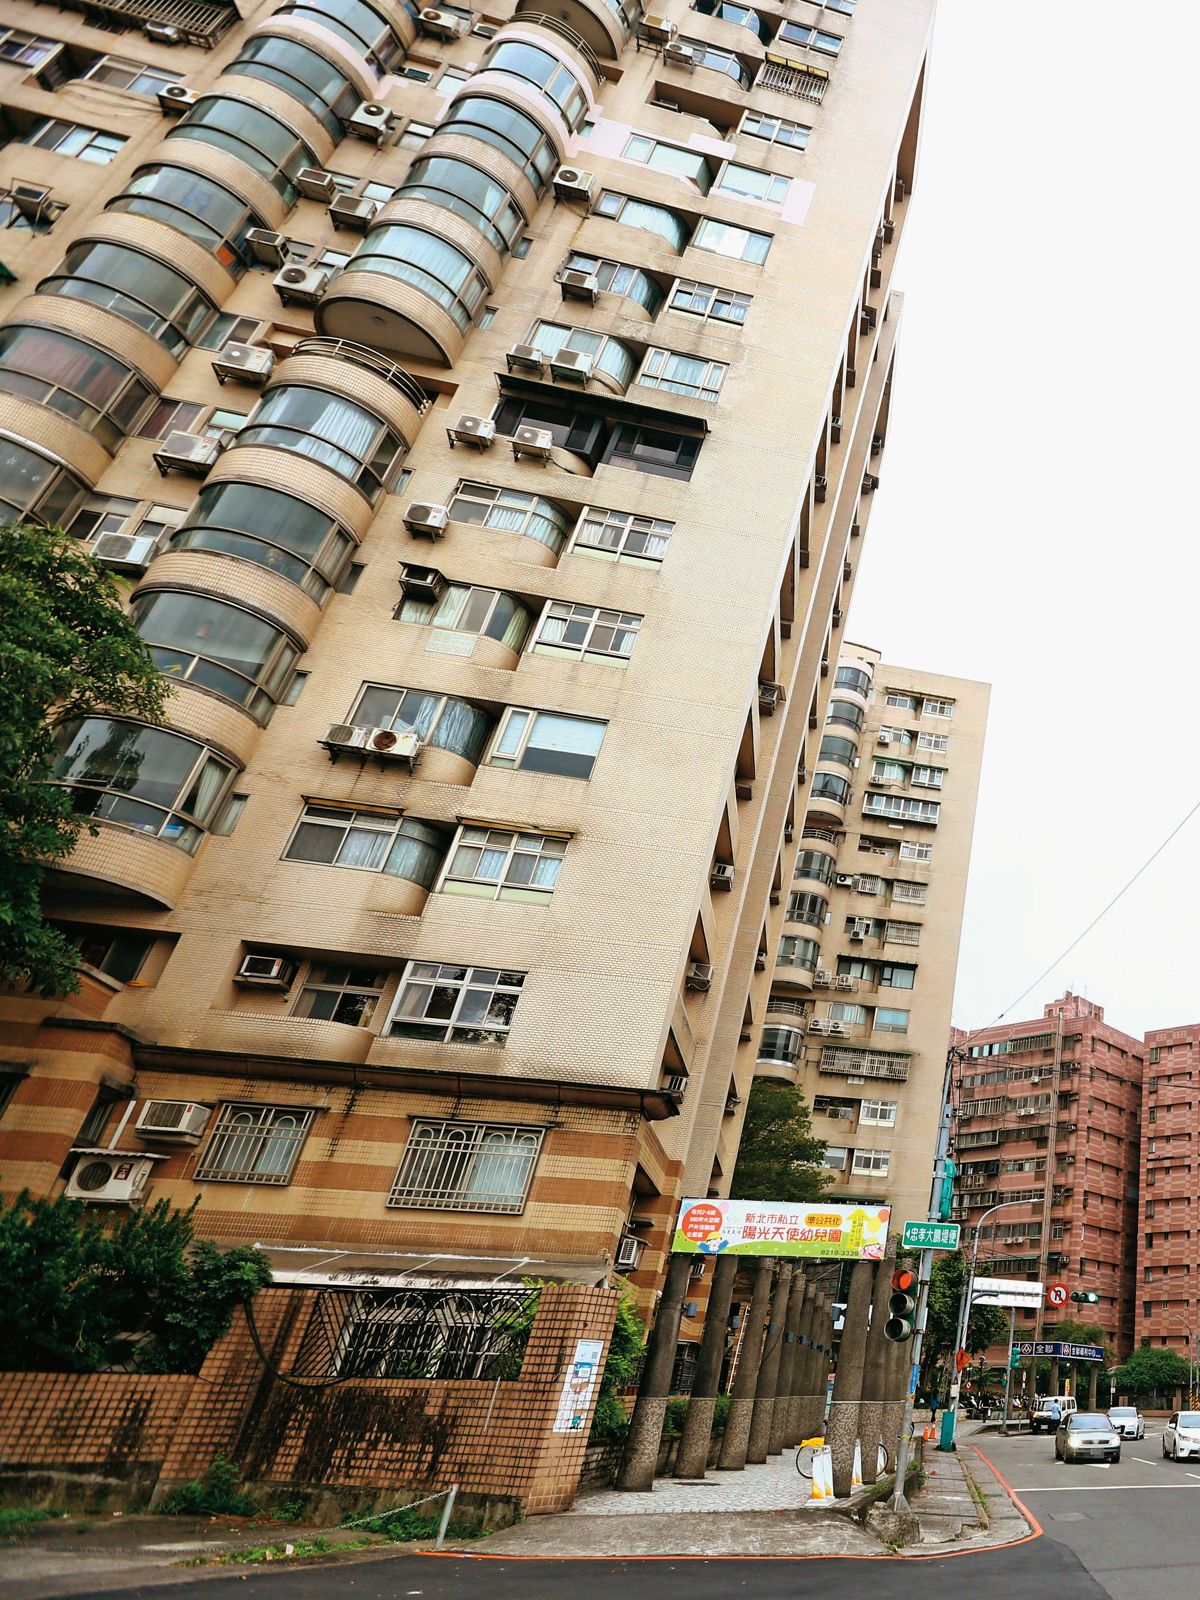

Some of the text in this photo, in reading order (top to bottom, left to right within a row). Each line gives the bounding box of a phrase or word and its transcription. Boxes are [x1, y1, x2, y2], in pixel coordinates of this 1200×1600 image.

[745, 1213, 799, 1225] 新北市私立
[807, 1215, 840, 1225] 準公共化
[742, 1226, 842, 1243] 陽光天使幼兒園
[820, 1249, 859, 1257] 8218-3339
[1036, 1344, 1054, 1354] 全聯
